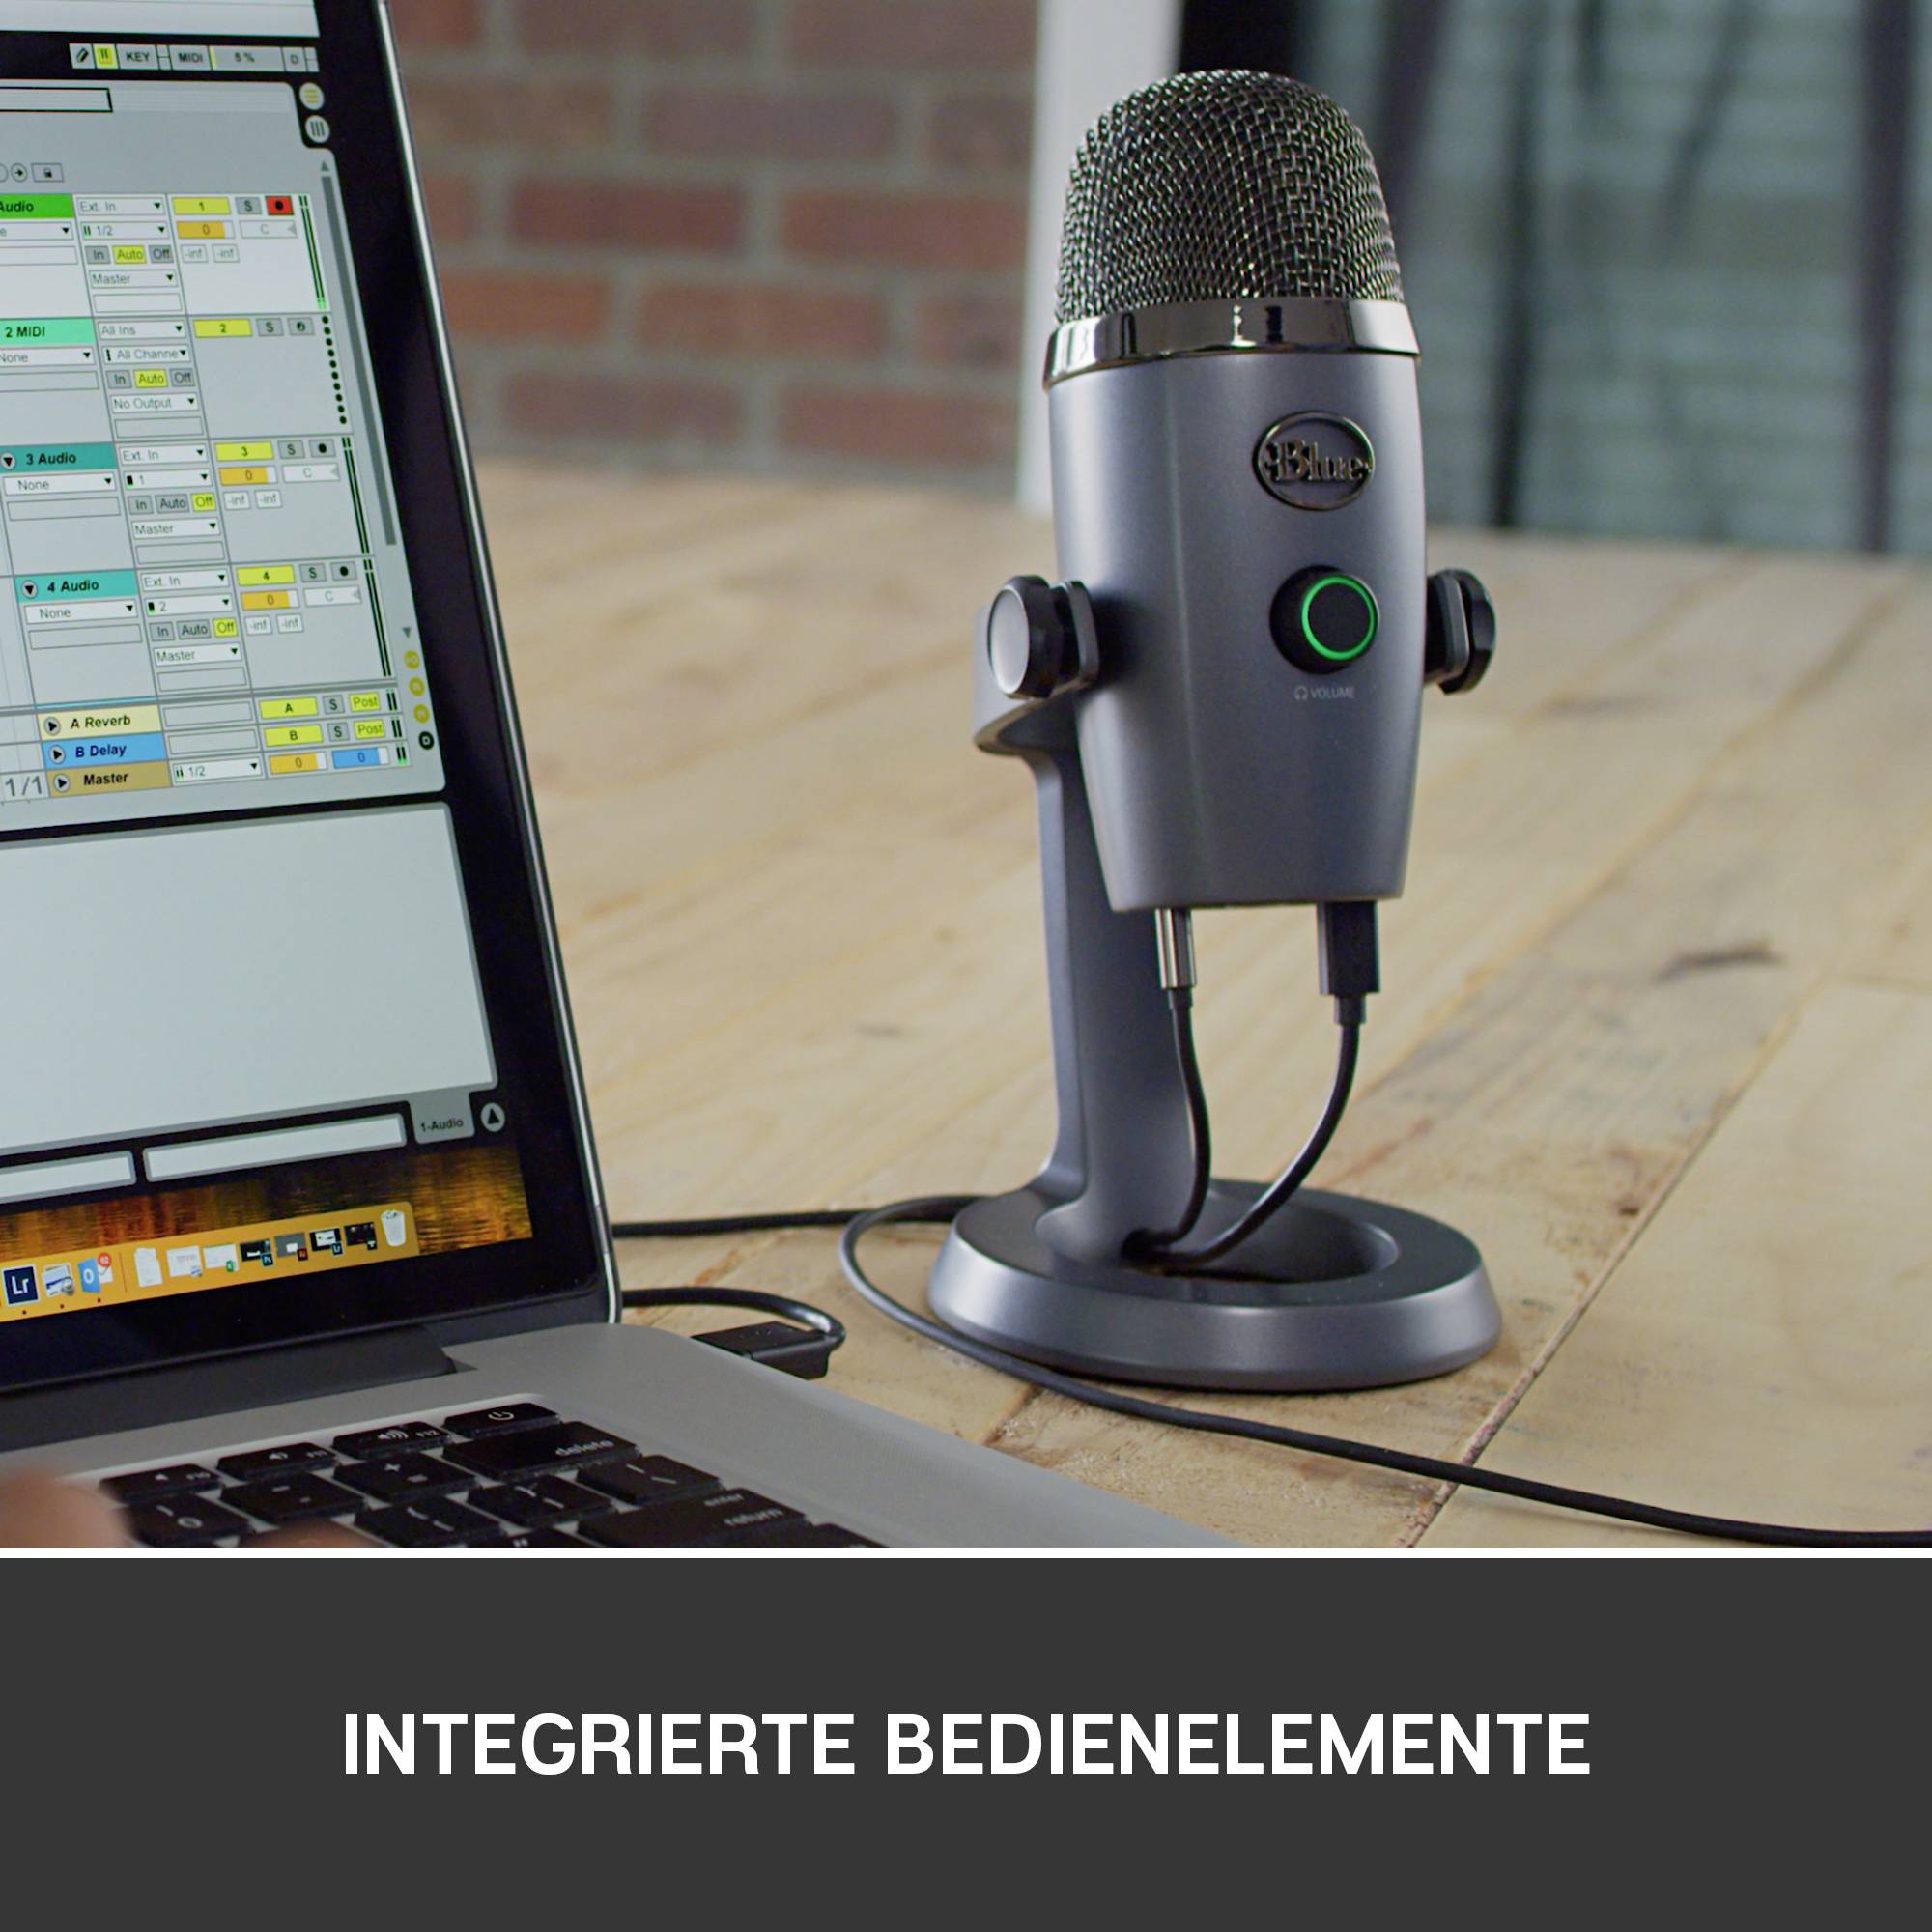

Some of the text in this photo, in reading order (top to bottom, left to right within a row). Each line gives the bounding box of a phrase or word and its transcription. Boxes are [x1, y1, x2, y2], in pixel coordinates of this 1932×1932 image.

[126, 51, 150, 63] KEY
[179, 51, 203, 64] MIDI
[244, 52, 255, 63] %
[103, 201, 116, 212] In
[244, 201, 252, 212] S
[97, 224, 113, 236] 1/2
[93, 249, 104, 261] In
[117, 248, 143, 261] Auto
[153, 248, 170, 260] Off
[92, 273, 130, 286] Master
[6, 327, 45, 338] 2 MIDI
[101, 325, 136, 336] All Ins
[220, 324, 226, 333] 2
[266, 322, 273, 332] S
[0, 353, 28, 363] None
[117, 349, 178, 359] All Channe
[114, 374, 126, 384] In
[138, 373, 164, 384] Auto
[174, 372, 191, 383] Off
[114, 397, 172, 410] No Output
[146, 449, 158, 460] In
[242, 446, 248, 457] 3
[287, 445, 295, 456] S
[26, 452, 76, 465] 3 Audio
[1265, 439, 1366, 483] Blue
[18, 479, 49, 491] None
[135, 499, 147, 510] In
[159, 497, 186, 509] Auto
[196, 496, 214, 507] Off
[134, 523, 173, 535] Master
[263, 571, 270, 582] 4
[309, 567, 317, 578] S
[46, 580, 99, 592] 4 Audio
[167, 576, 180, 586] In
[159, 601, 166, 611] 2
[40, 607, 71, 618] None
[156, 626, 168, 637] In
[182, 623, 208, 636] Auto
[216, 621, 235, 633] Off
[156, 649, 195, 662] Master
[1311, 687, 1354, 699] VOLUME
[328, 699, 337, 710] S
[353, 696, 378, 708] Post
[284, 703, 293, 714] A
[71, 715, 130, 729] A Reverb
[290, 730, 298, 741] B
[333, 726, 342, 737] S
[356, 724, 383, 735] Post
[75, 744, 127, 759] B Delay
[188, 765, 206, 778] 1/2
[83, 772, 128, 785] Master
[5, 776, 42, 797] 1/1
[420, 1118, 464, 1132] 1-Audio
[12, 1276, 30, 1295] Lr
[556, 1438, 613, 1456] delete
[704, 1494, 744, 1507] enter
[724, 1509, 783, 1526] return
